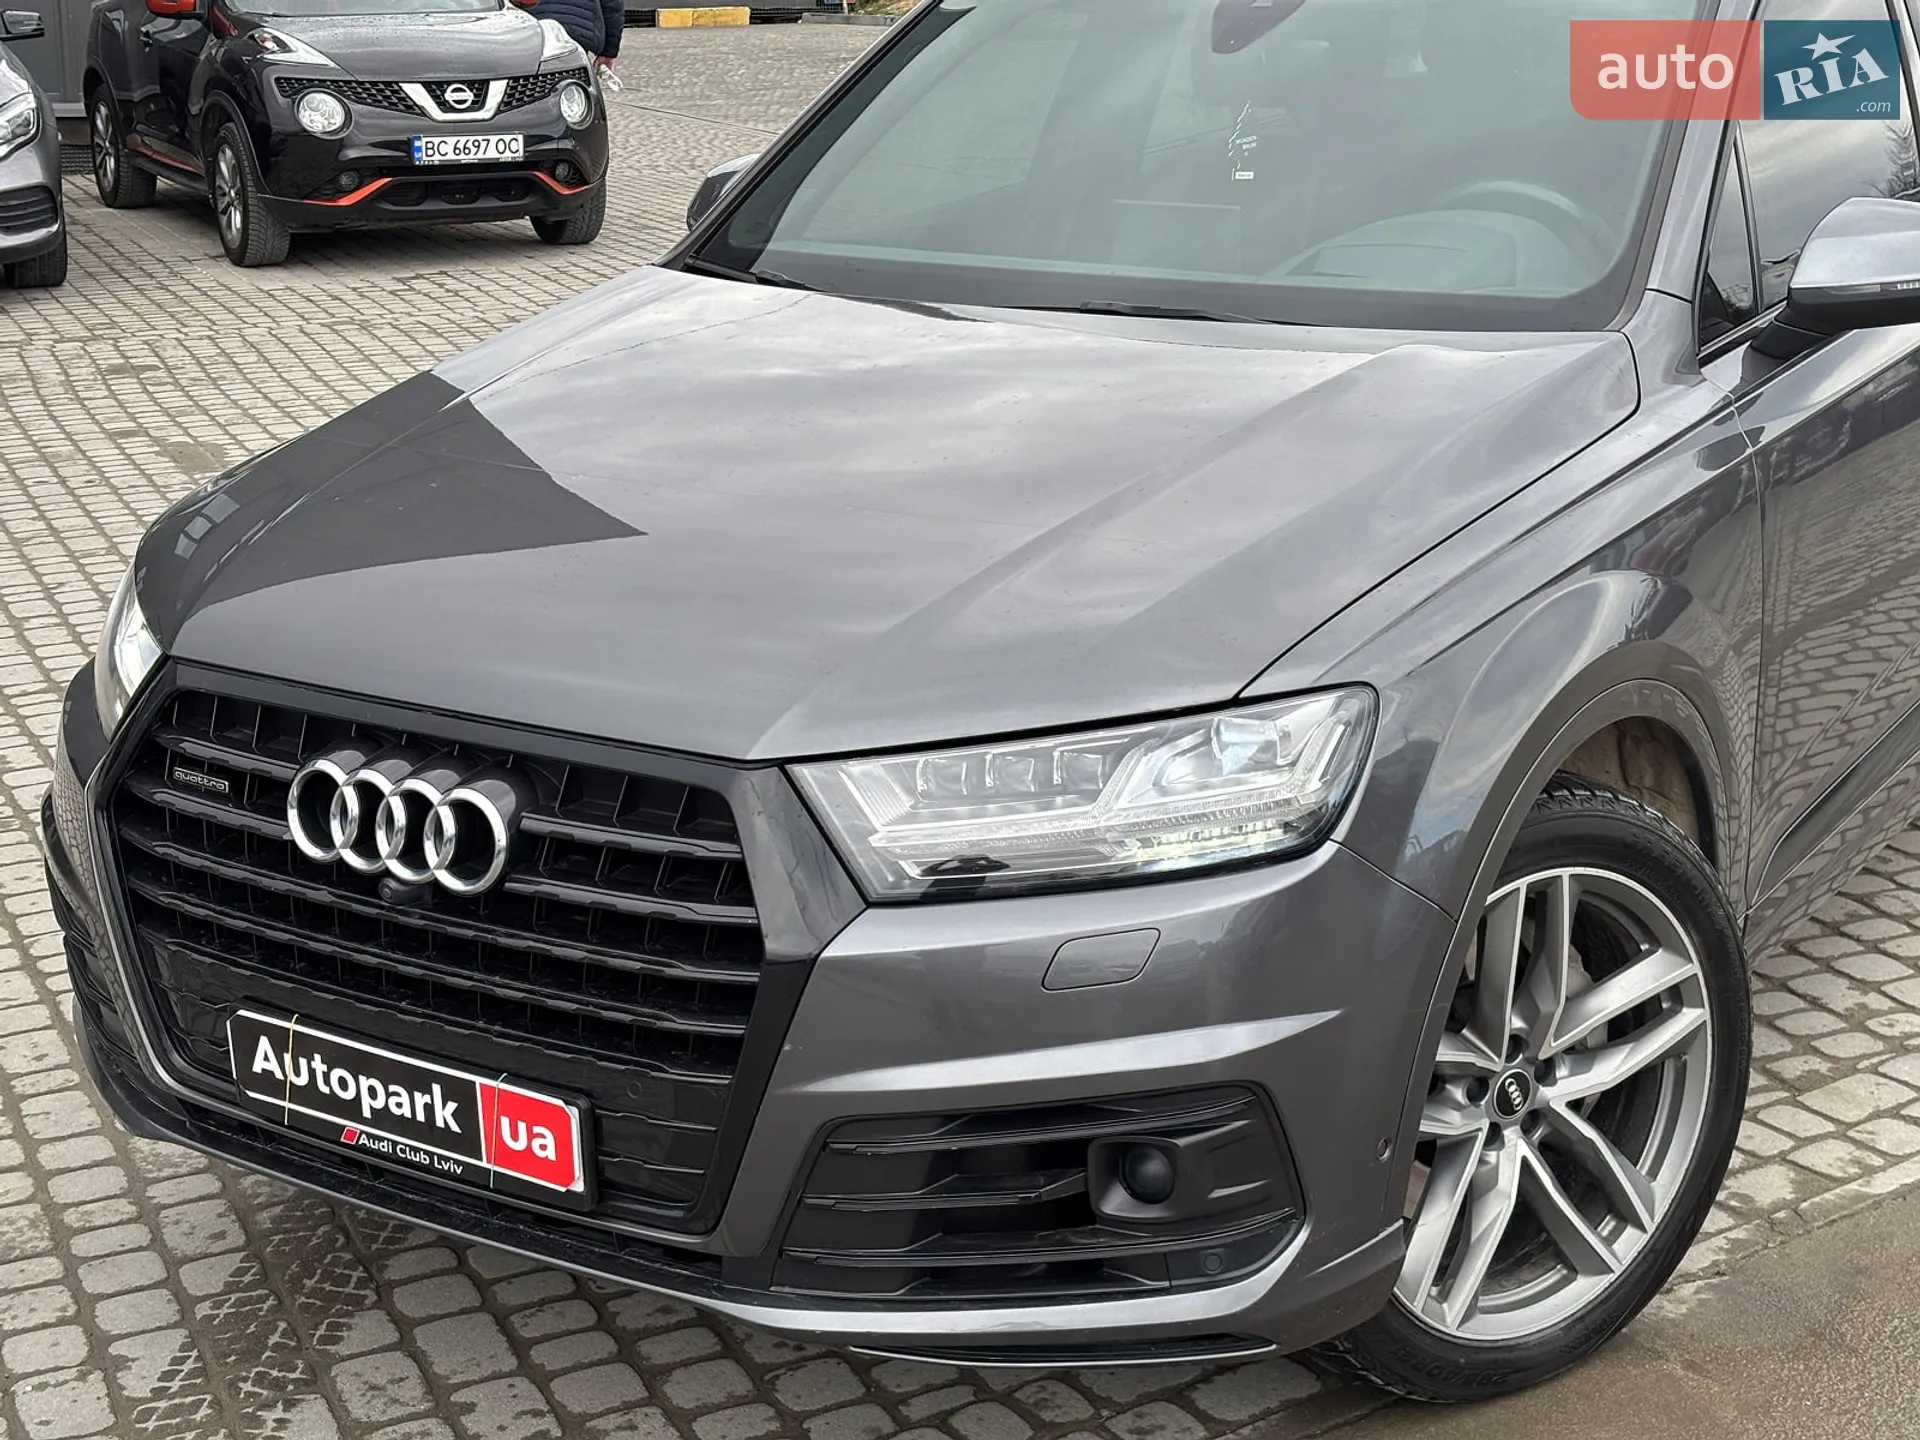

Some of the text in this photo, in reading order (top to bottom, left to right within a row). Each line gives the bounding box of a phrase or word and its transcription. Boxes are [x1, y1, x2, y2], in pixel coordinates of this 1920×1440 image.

[424, 137, 519, 158] BC 6697 OC
[175, 771, 225, 790] quattro
[251, 1035, 556, 1161] Autopark ua
[358, 1133, 463, 1175] Audi Club Lviv
